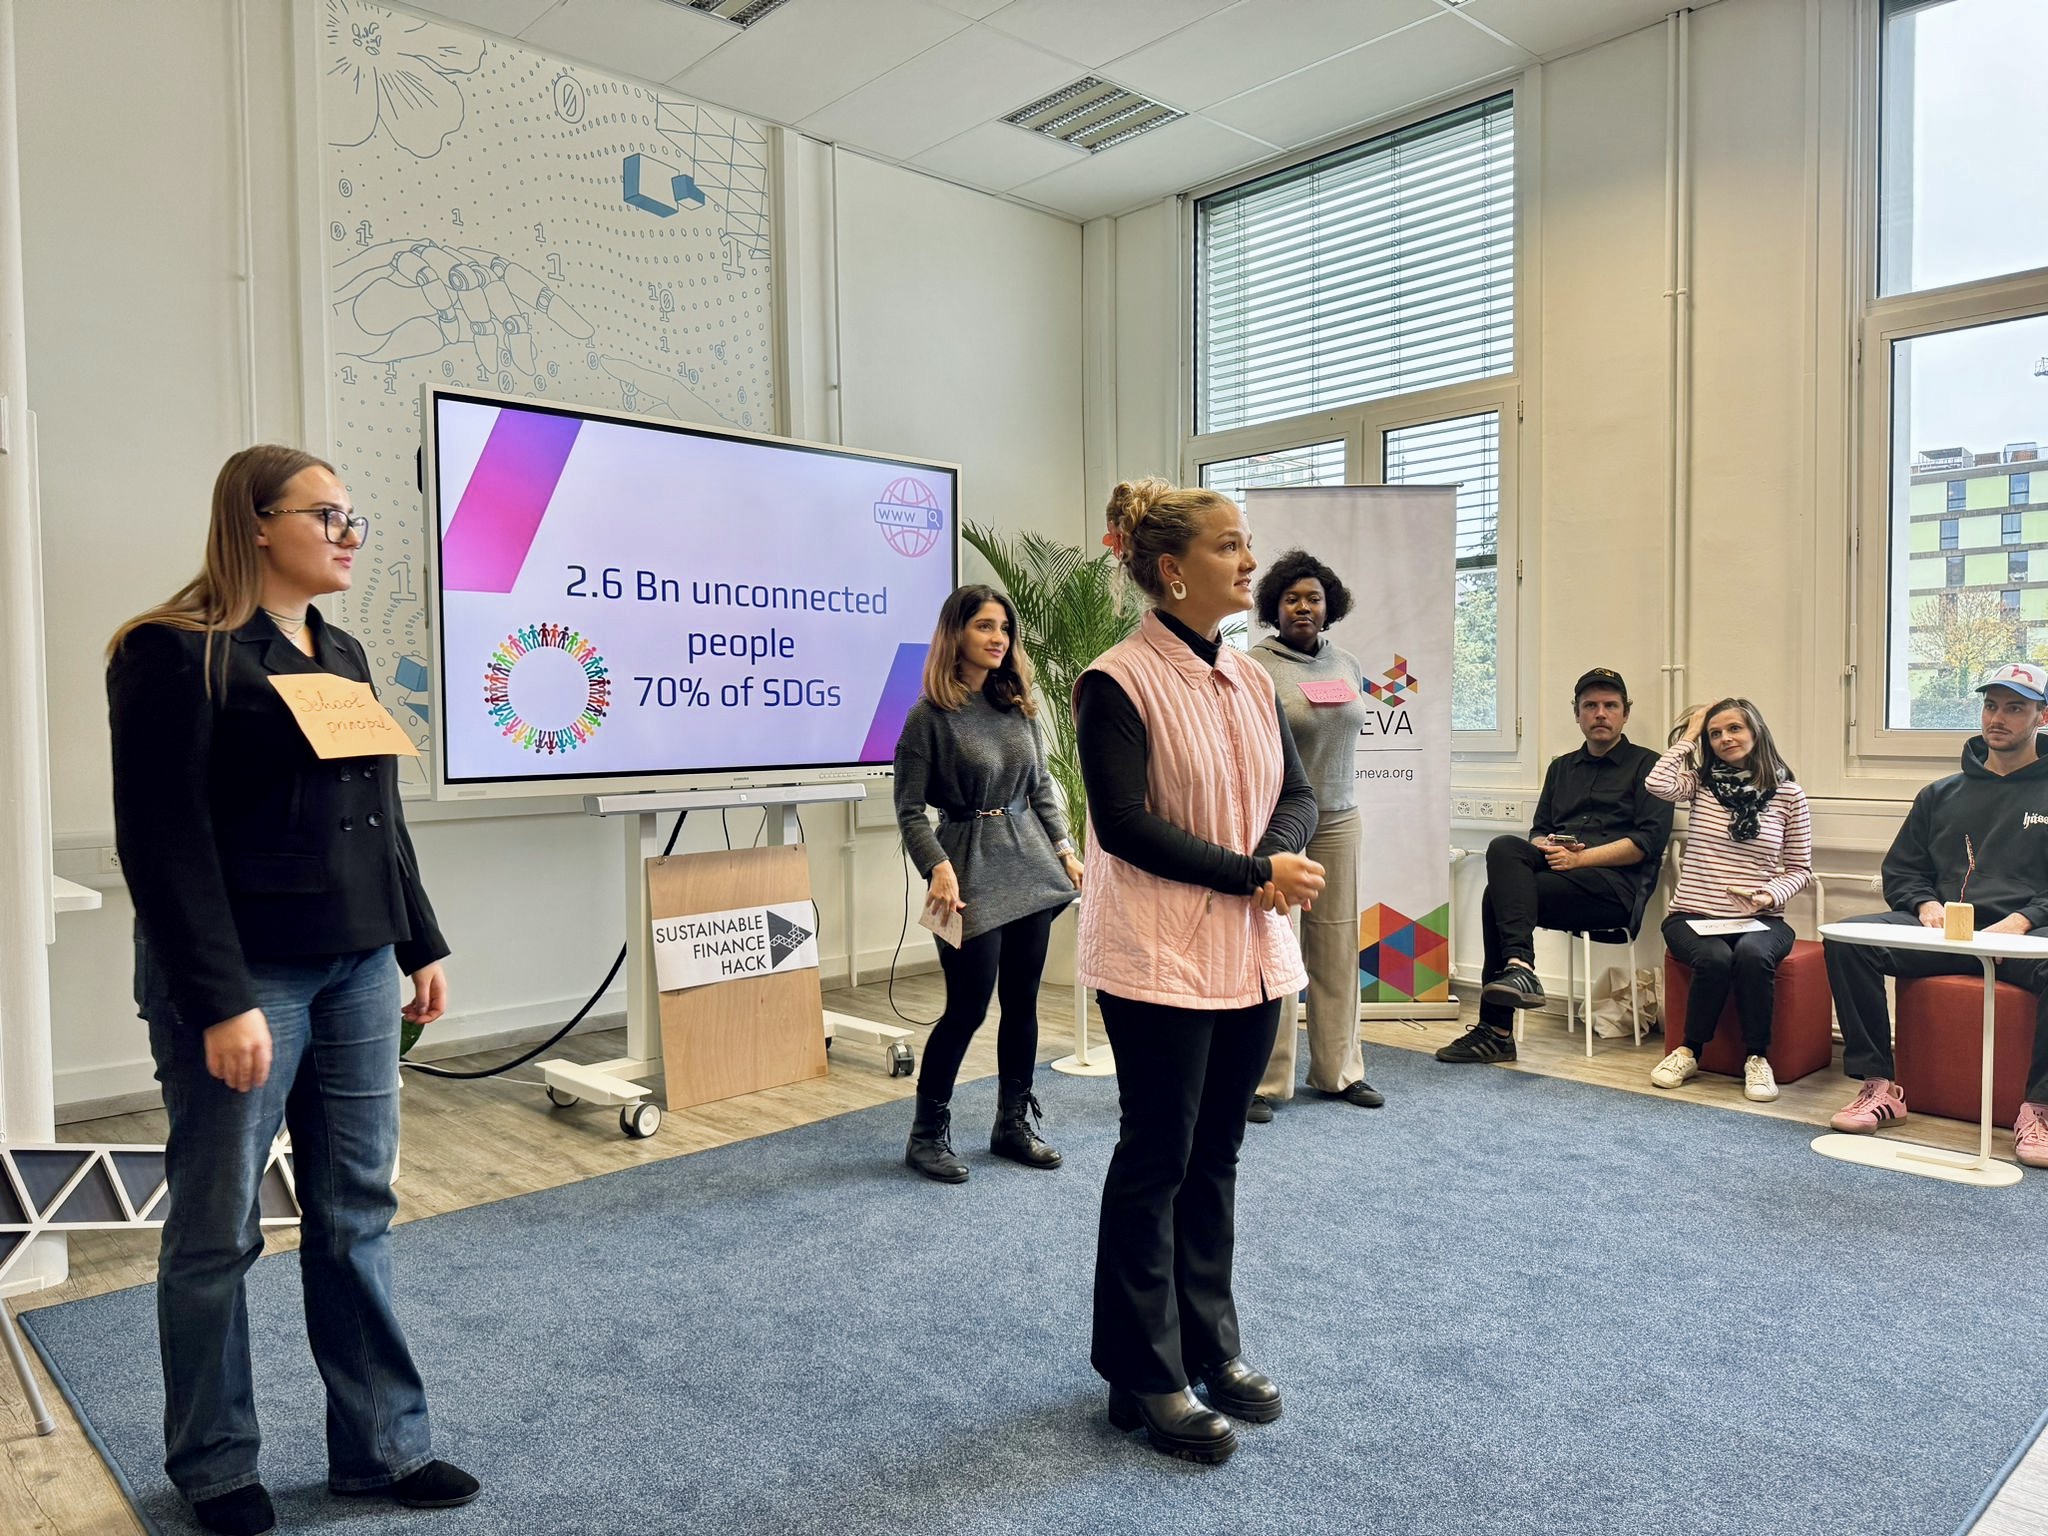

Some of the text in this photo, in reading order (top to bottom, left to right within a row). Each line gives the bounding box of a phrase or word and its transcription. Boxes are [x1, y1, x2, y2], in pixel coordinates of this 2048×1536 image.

[546, 253, 565, 281] 1
[388, 561, 417, 601] 1
[566, 565, 887, 615] 2.6 Bn unconnected
[689, 628, 795, 665] people
[634, 676, 841, 707] 70% of SDGs
[656, 914, 763, 944] SUSTAINABLE
[693, 934, 765, 959] FINANCE
[721, 954, 767, 976] HACK
